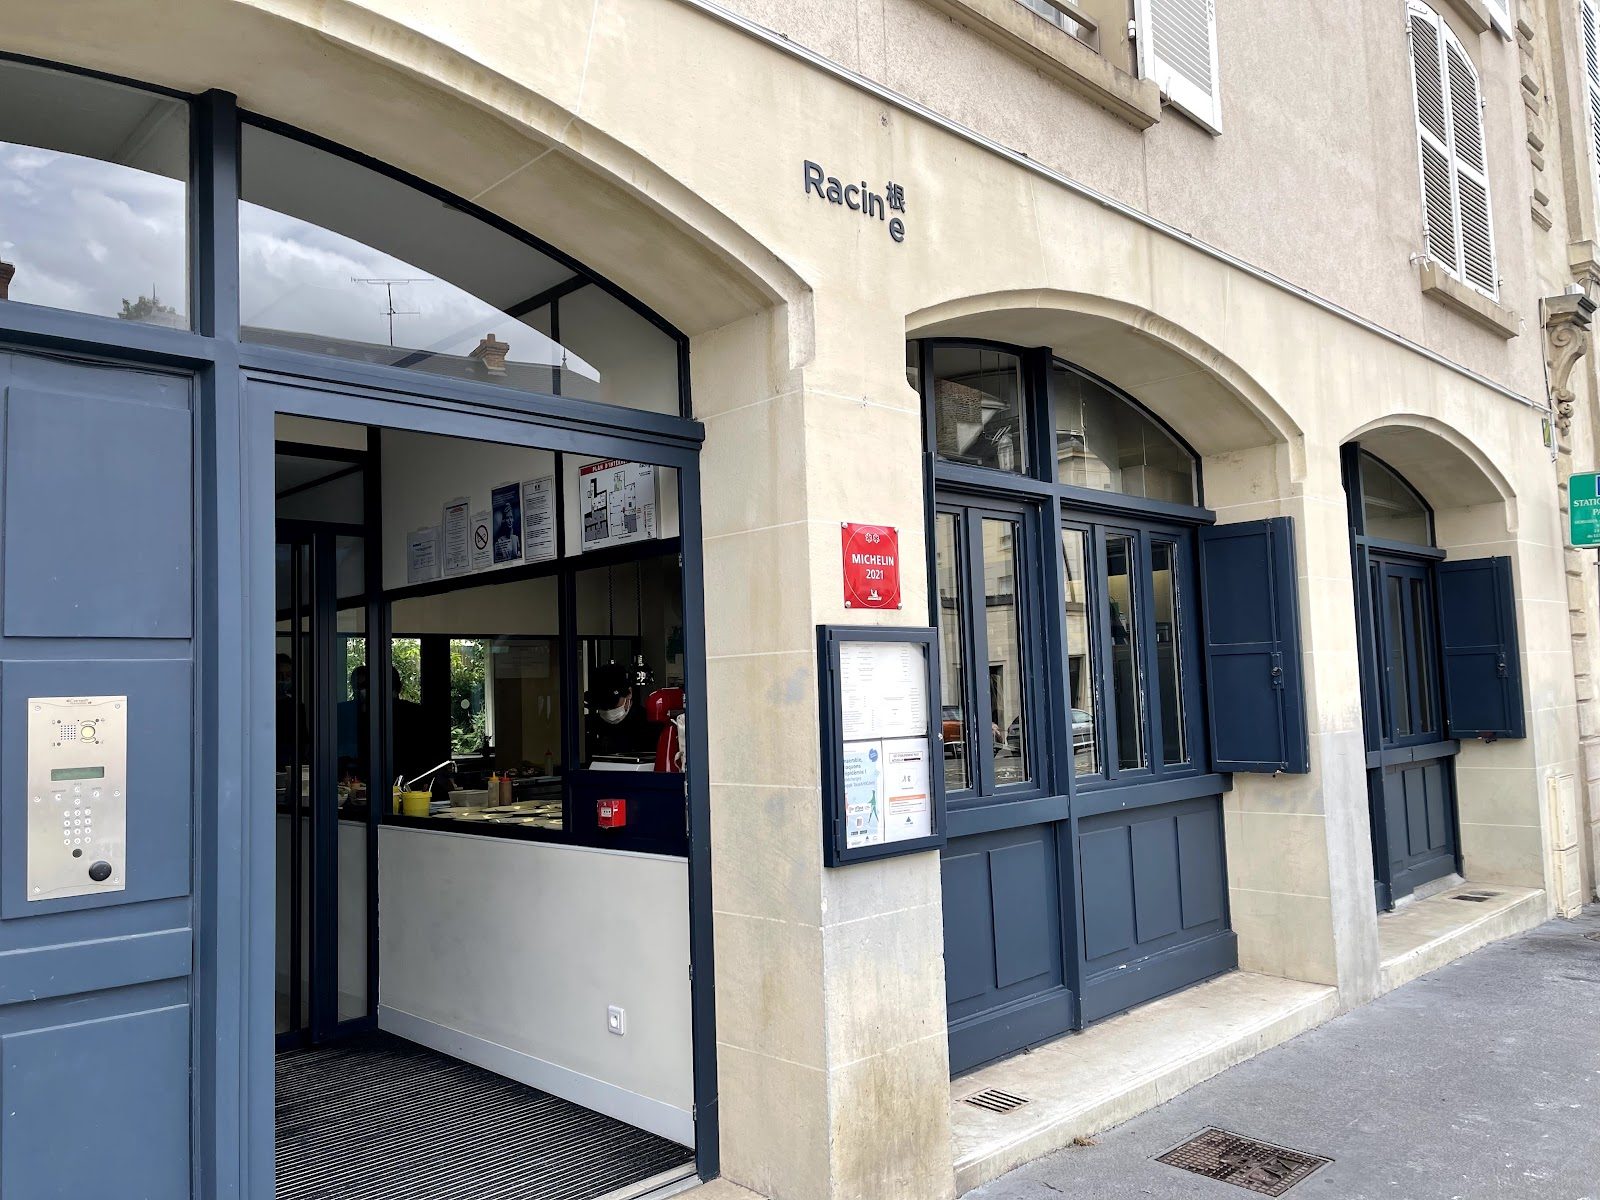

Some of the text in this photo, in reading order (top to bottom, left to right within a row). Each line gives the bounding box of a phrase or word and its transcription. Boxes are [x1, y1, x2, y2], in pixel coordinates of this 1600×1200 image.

[886, 180, 906, 213] 根
[592, 464, 604, 472] PLAN
[851, 553, 895, 566] MICHELIN
[865, 569, 884, 580] 2021
